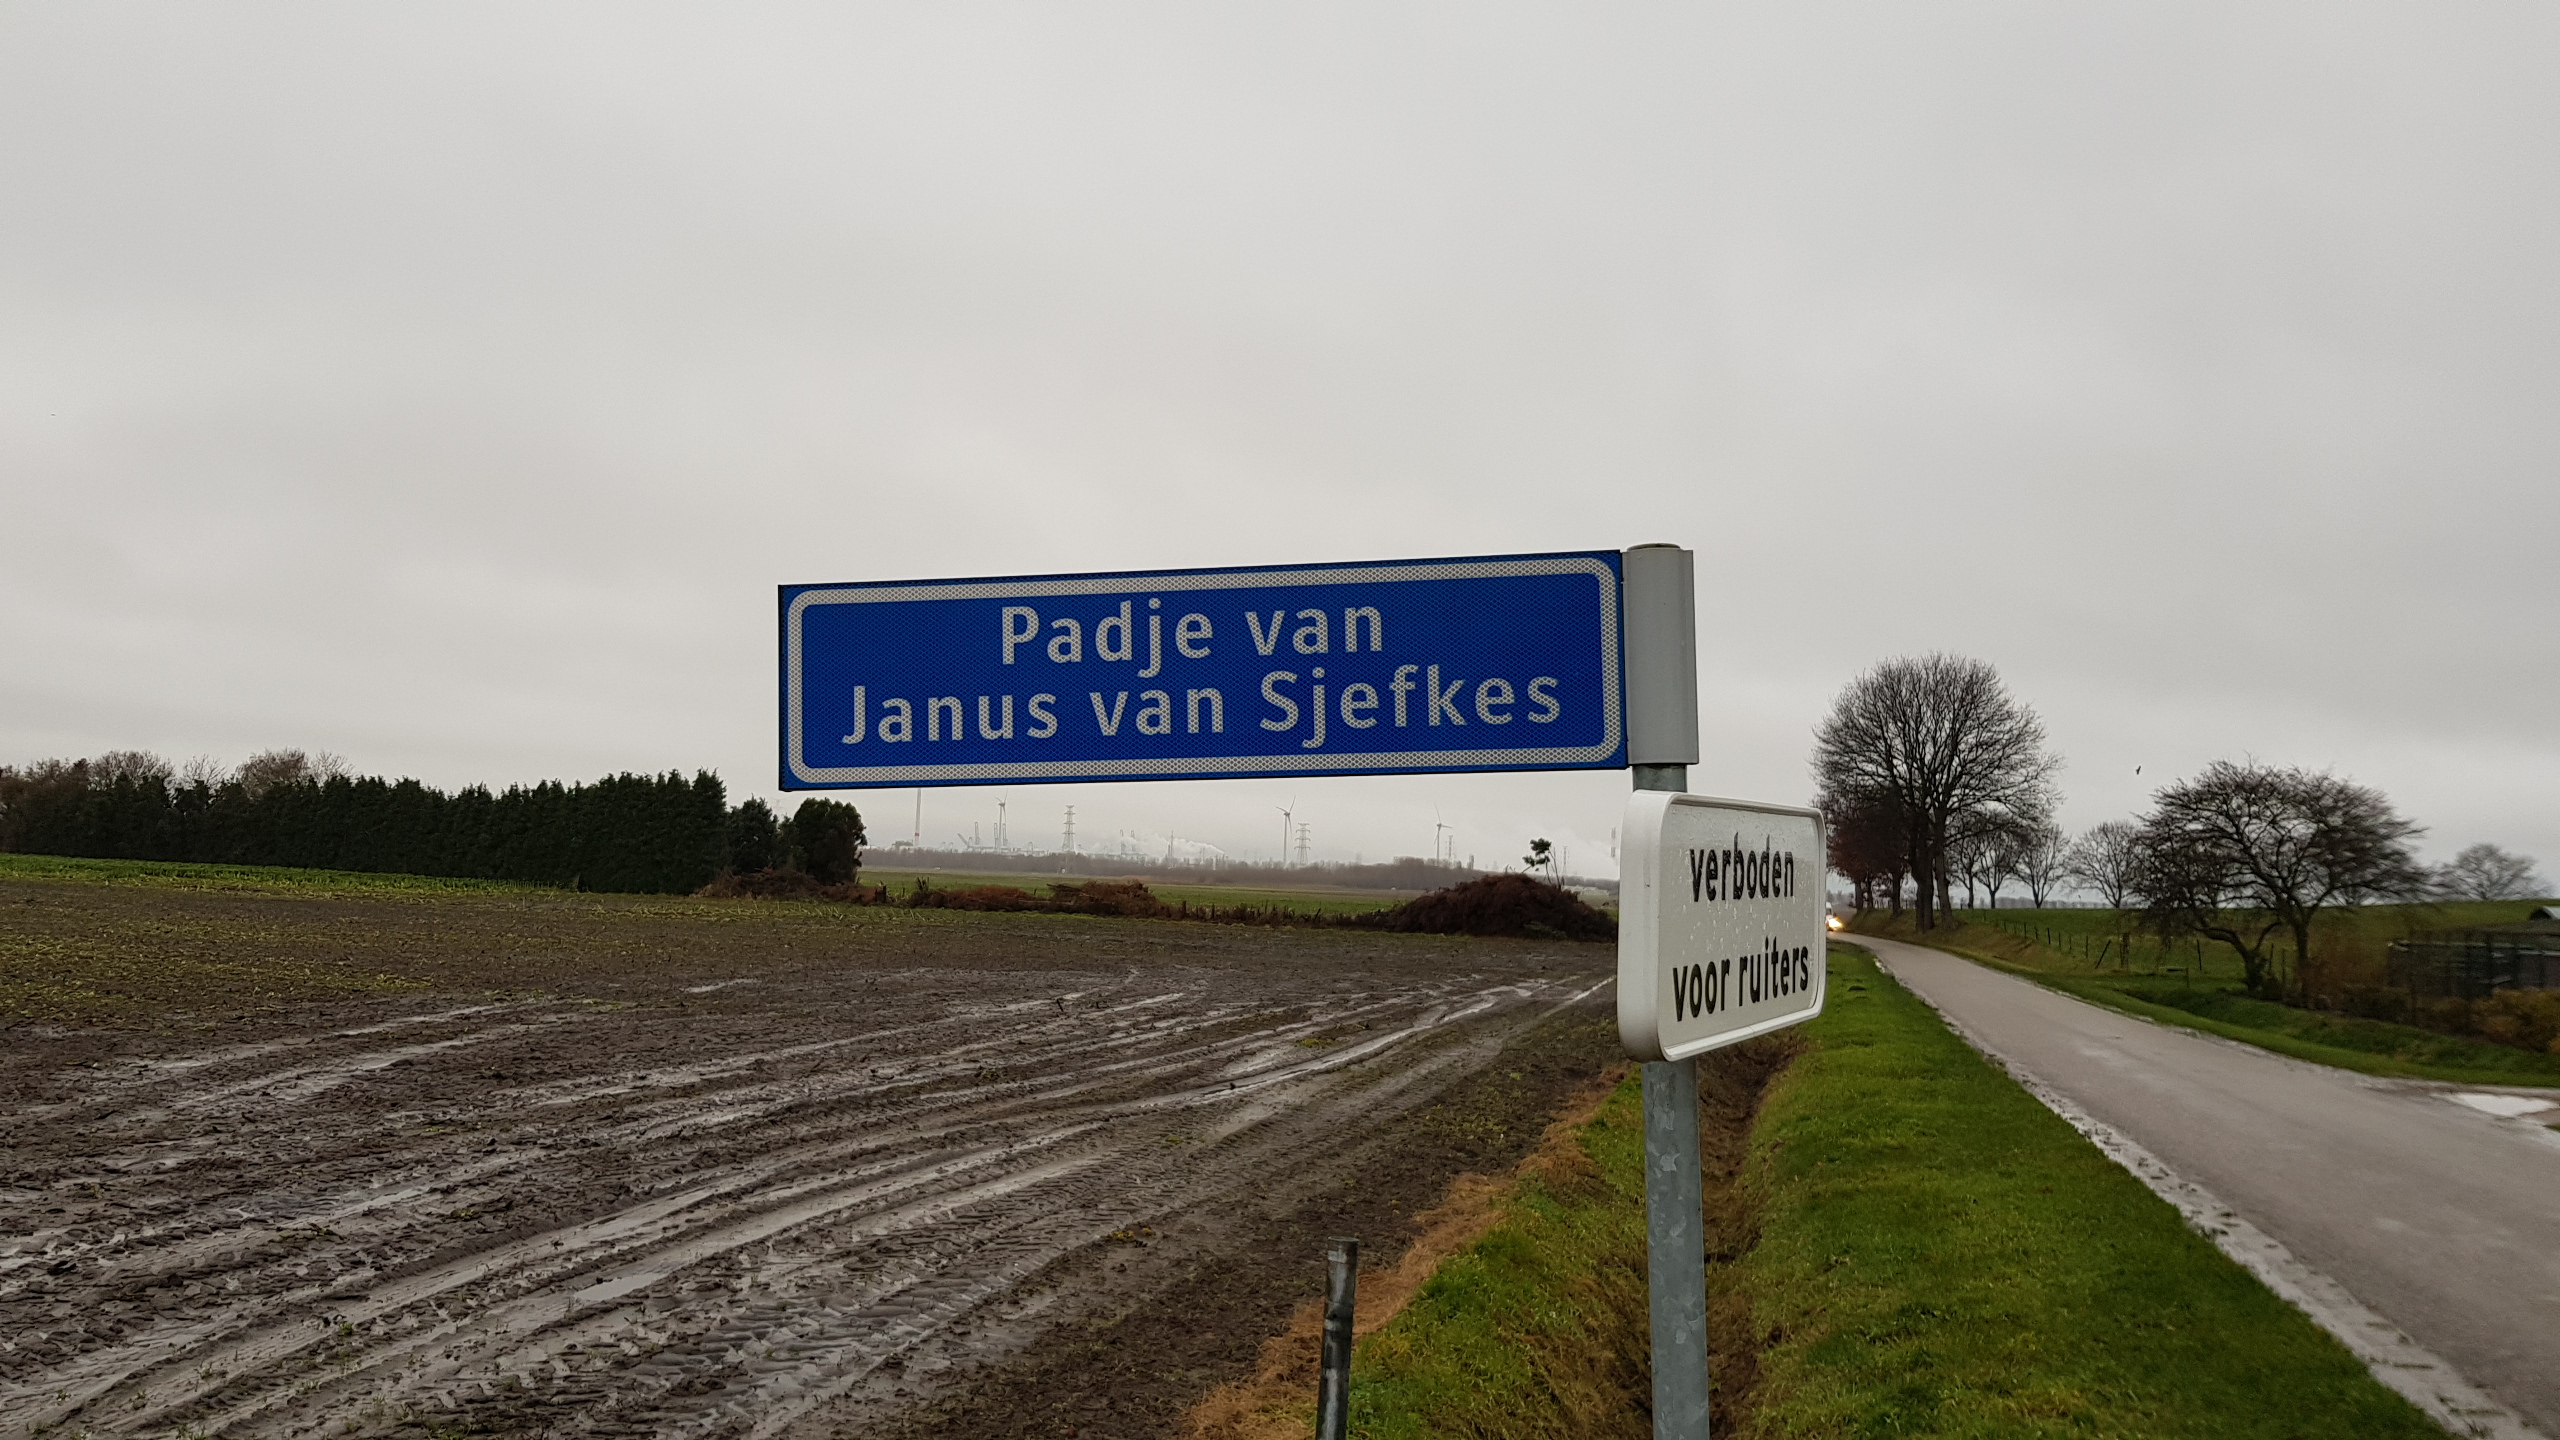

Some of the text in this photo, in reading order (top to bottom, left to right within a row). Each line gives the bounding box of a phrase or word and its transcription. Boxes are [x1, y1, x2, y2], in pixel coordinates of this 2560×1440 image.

[1001, 597, 1384, 678] Padje van
[842, 664, 1562, 749] Janus van Sjefkes
[1689, 831, 1795, 902] verboden
[1672, 936, 1809, 1022] voor ruiters
